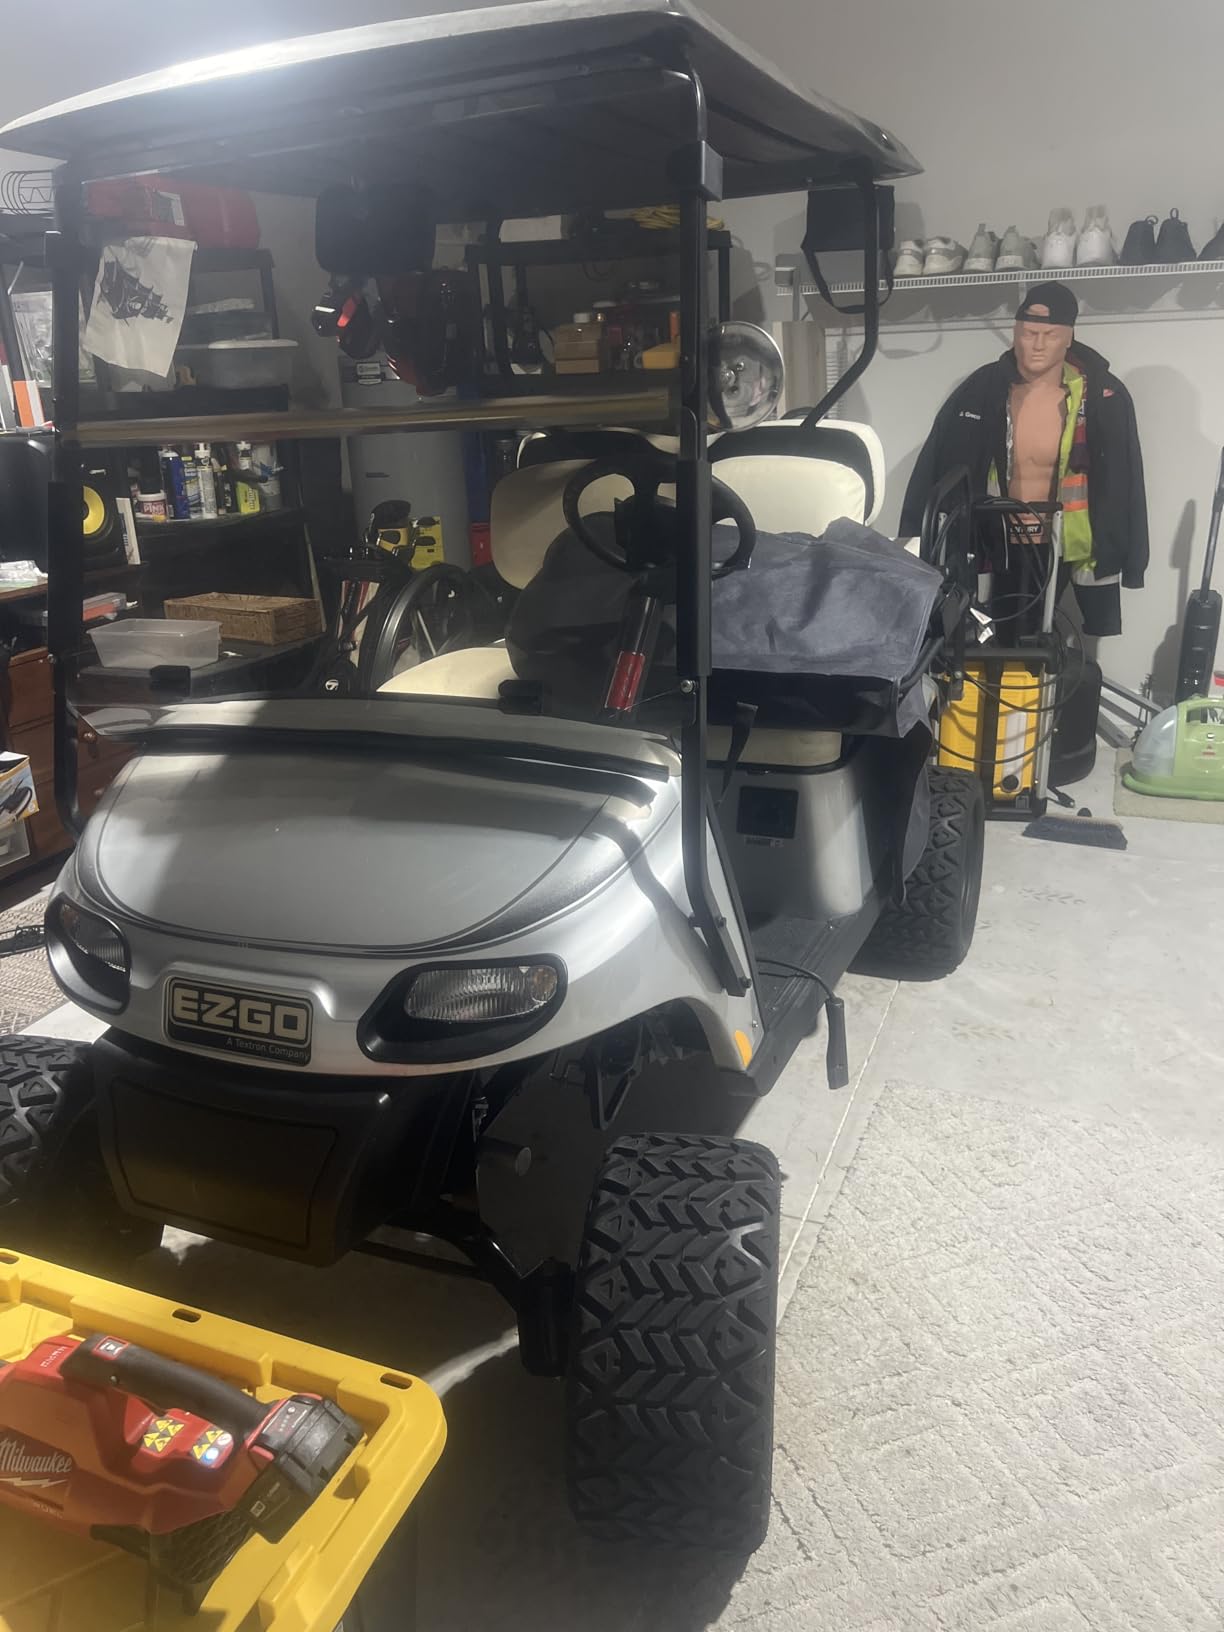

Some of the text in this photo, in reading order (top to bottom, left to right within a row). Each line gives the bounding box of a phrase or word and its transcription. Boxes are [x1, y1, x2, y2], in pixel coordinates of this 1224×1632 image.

[173, 987, 308, 1041] EZGO
[225, 1036, 310, 1060] A Textron Company
[0, 1437, 73, 1473] Milwaukee
